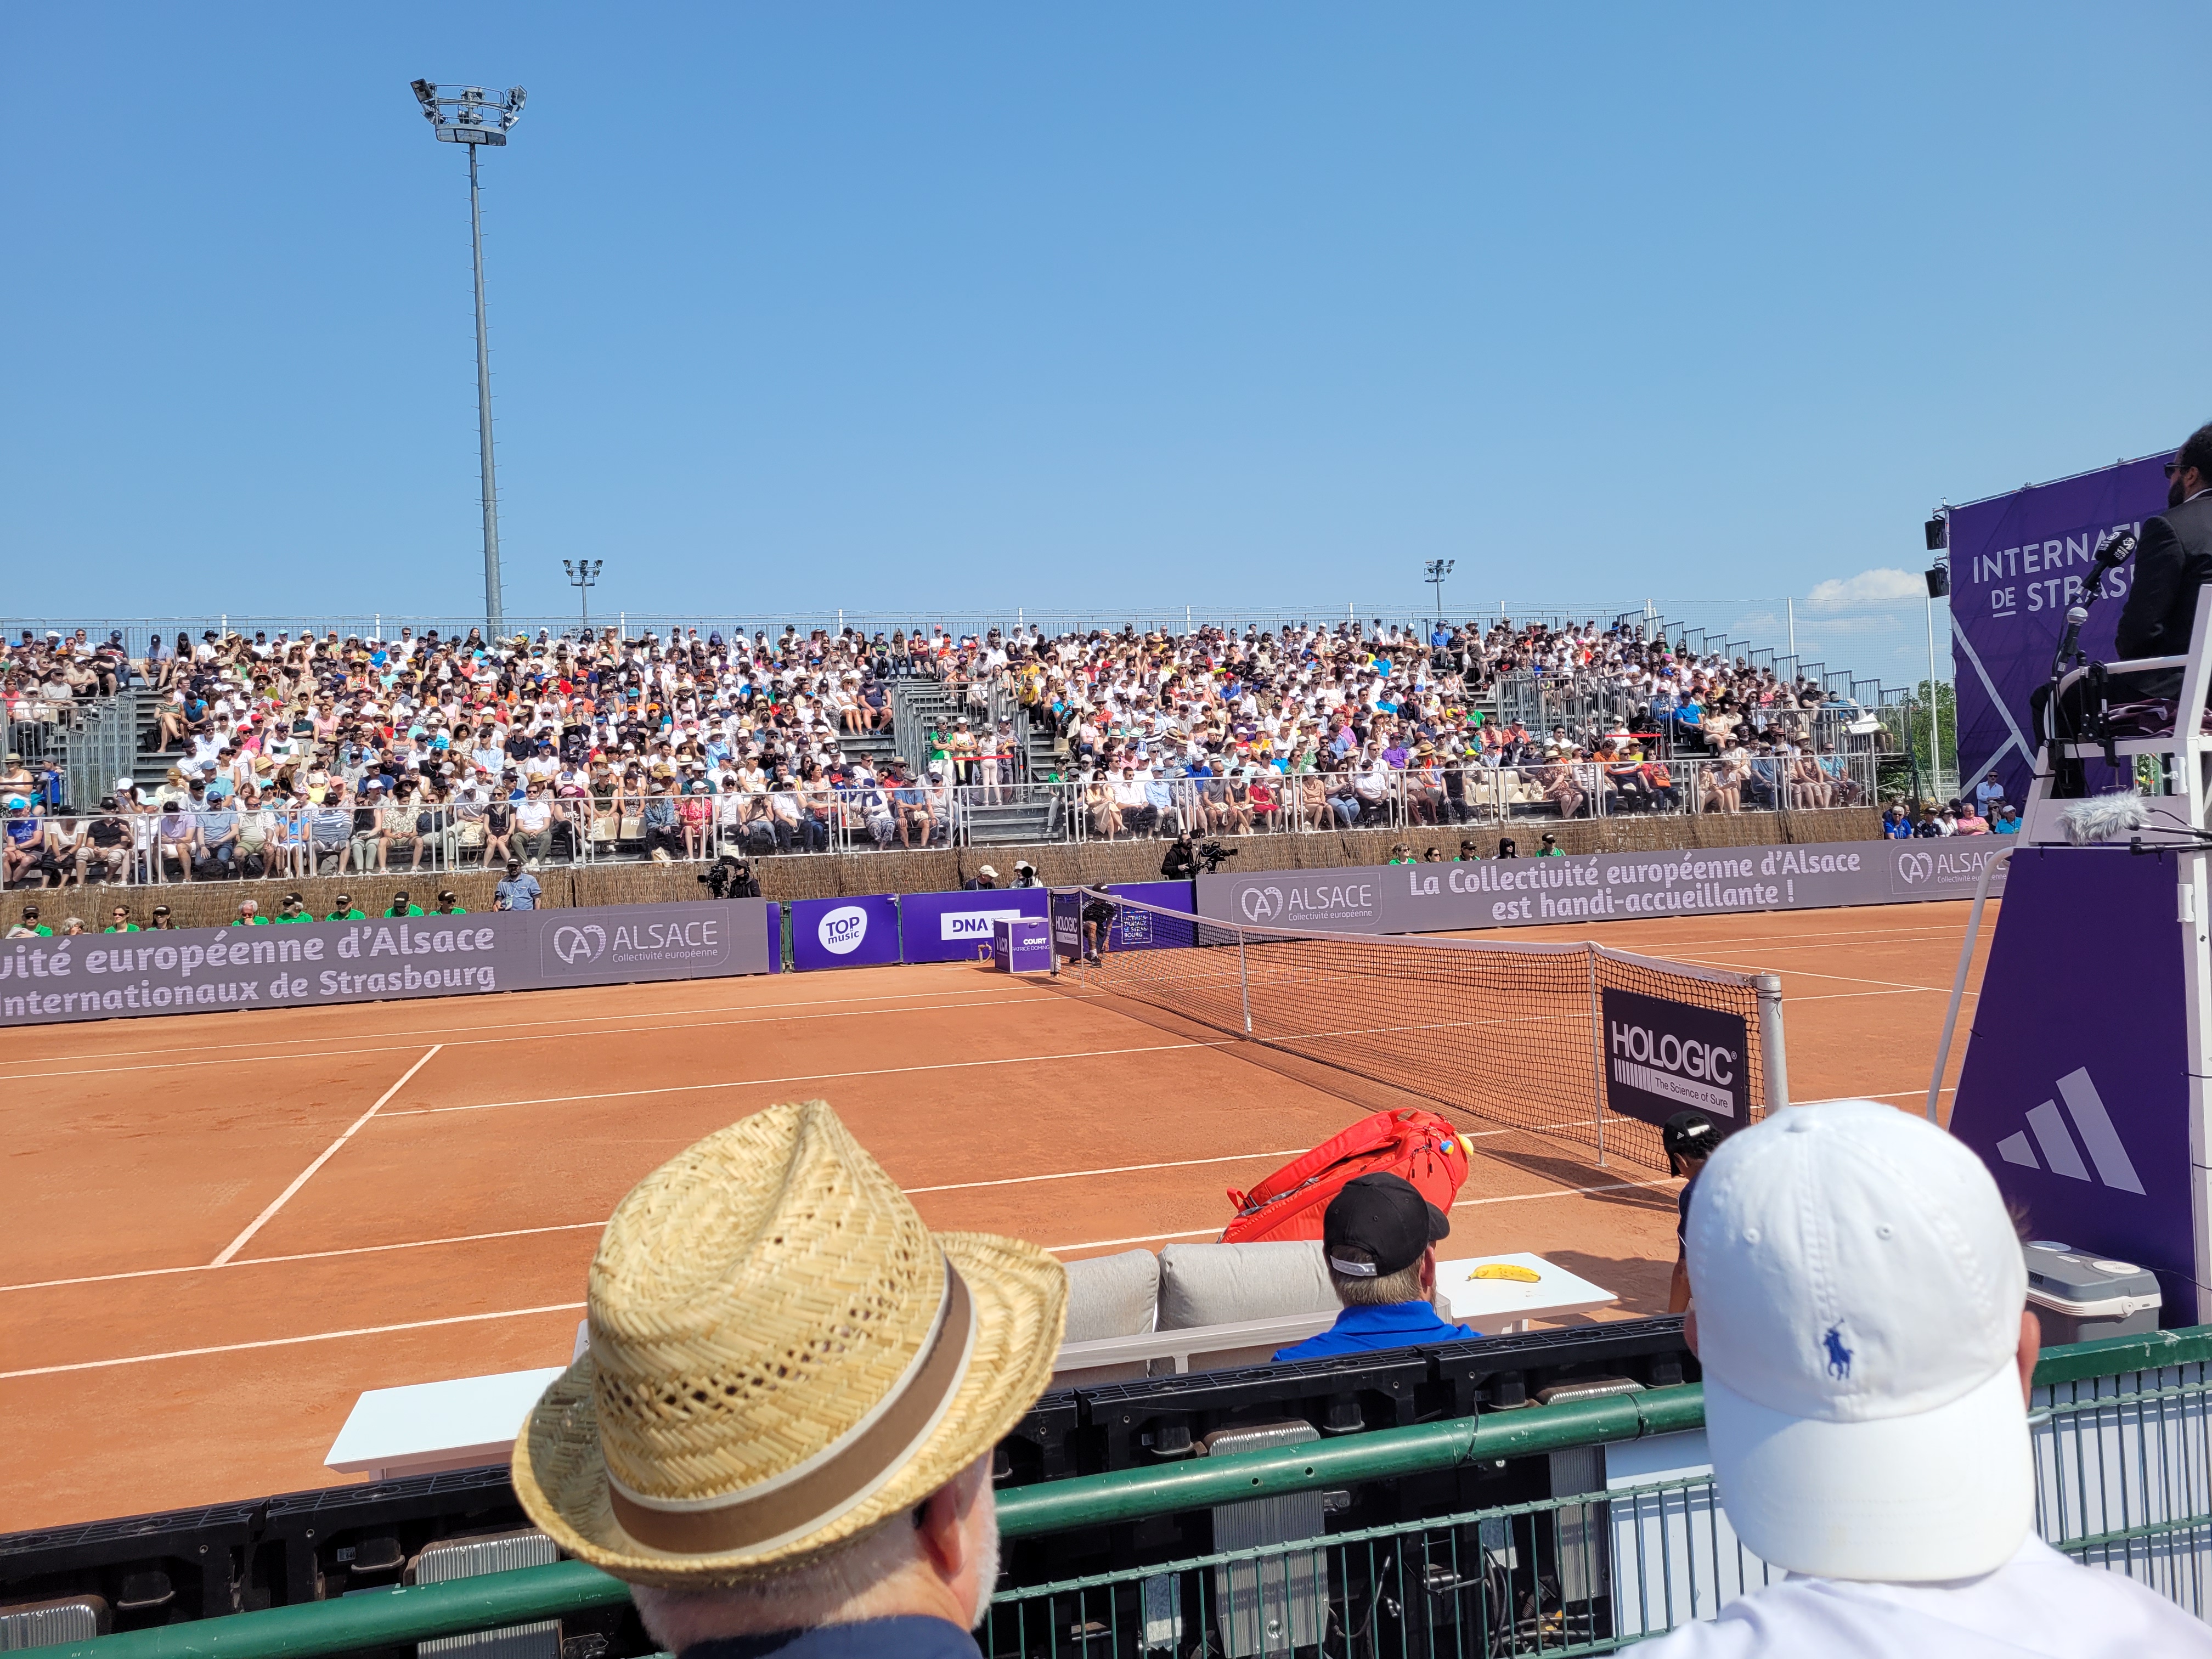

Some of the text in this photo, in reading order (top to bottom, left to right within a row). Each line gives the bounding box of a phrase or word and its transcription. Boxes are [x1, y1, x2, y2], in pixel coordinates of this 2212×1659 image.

[1991, 564, 2135, 612] DE STRS
[1409, 849, 1861, 896] La Collectivité européenne d'Alsace
[1937, 874, 1971, 883] Collectivité
[1288, 884, 1372, 911] ALSACE
[1492, 879, 1795, 921] est handi-accueillante !
[826, 916, 860, 936] TOP
[952, 918, 989, 933] DNA
[1056, 915, 1077, 933] HOLOGIC
[1288, 909, 1373, 921] Collectivité européenne
[612, 920, 718, 951] ALSACE
[828, 931, 860, 944] music
[86, 929, 324, 978] européenne
[337, 923, 494, 958] d'Alsace
[612, 949, 718, 962] Collectivité européenne
[0, 963, 495, 1017] nternationaux de Strasbourg
[1655, 1076, 1728, 1109] The Science of Sure
